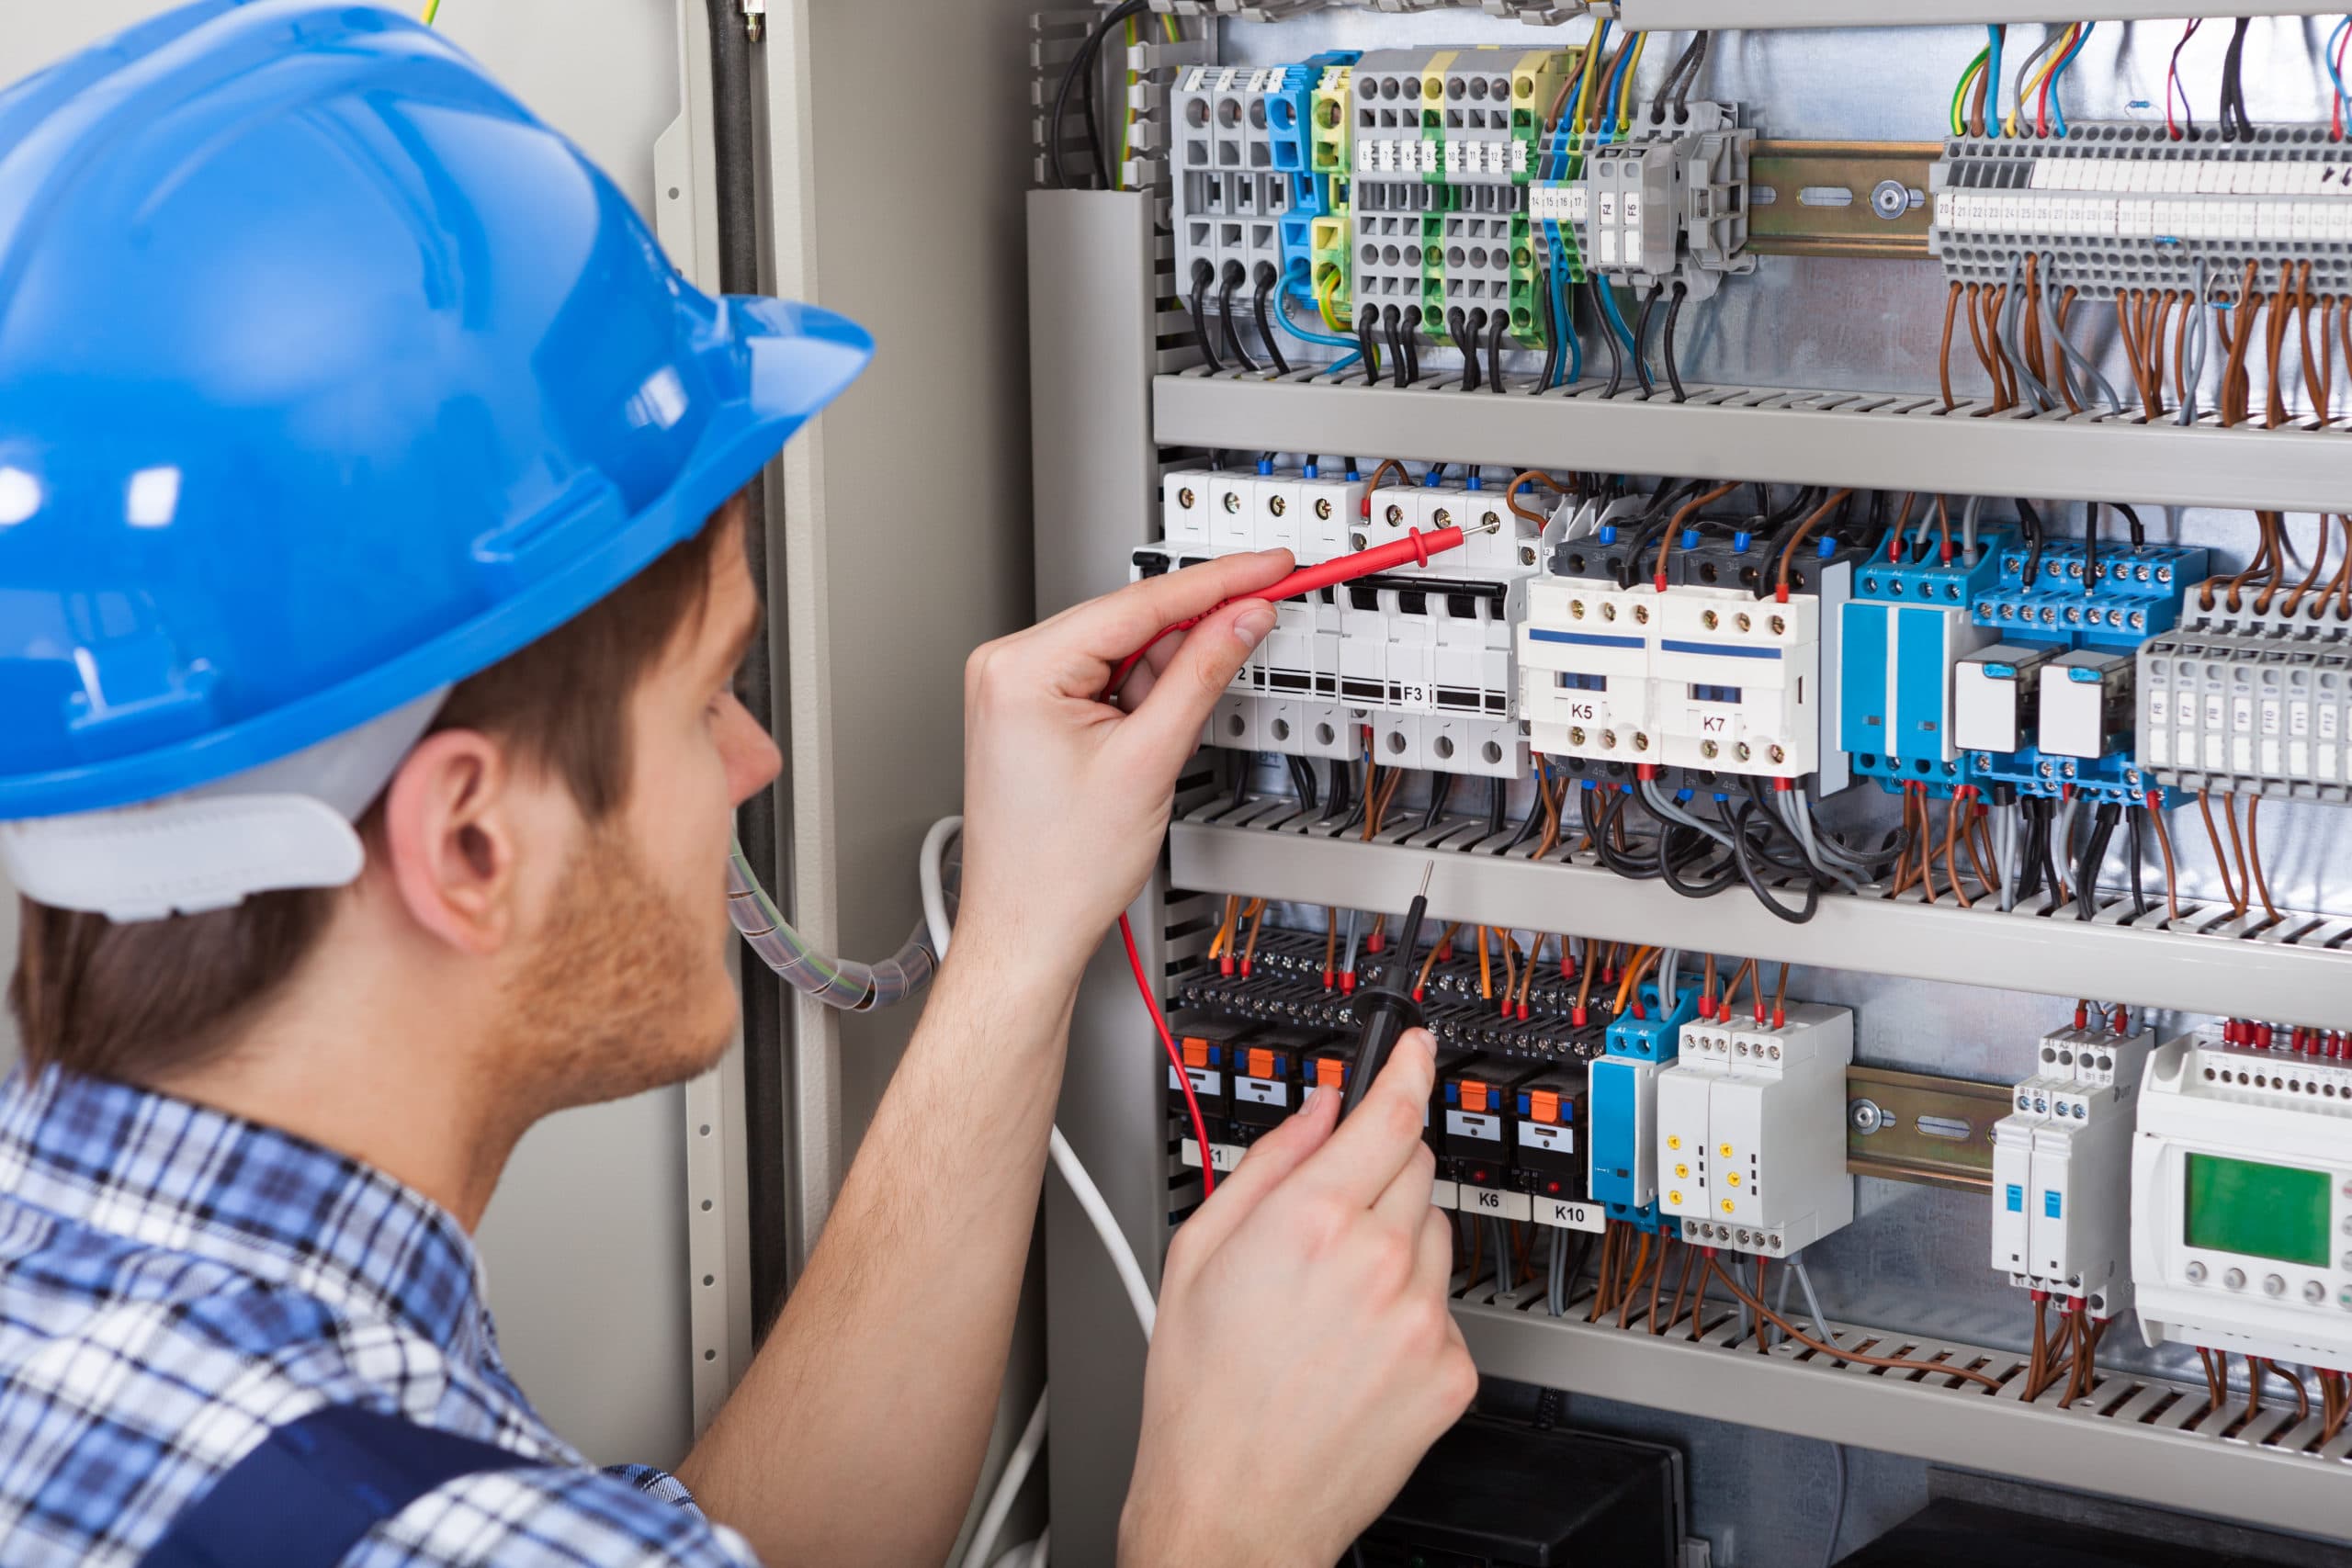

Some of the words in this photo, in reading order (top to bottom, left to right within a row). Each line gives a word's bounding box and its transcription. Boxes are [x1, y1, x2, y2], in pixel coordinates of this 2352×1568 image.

[1448, 152, 1455, 162] 10
[1469, 151, 1476, 160] 11
[1490, 152, 1498, 162] 12
[1514, 150, 1521, 160] 13
[1532, 197, 1539, 206] 14
[1546, 197, 1554, 207] 15
[1560, 197, 1567, 207] 16
[1574, 197, 1582, 207] 17
[1602, 204, 1611, 215] F4
[1939, 203, 1949, 214] 20
[1957, 206, 1966, 218] 21
[1973, 207, 1983, 218] 22
[1989, 208, 1999, 219] 23
[1403, 686, 1423, 701] F3
[1571, 703, 1593, 719] K5
[2182, 705, 2191, 717] F7
[1702, 716, 1725, 732] K7
[2265, 710, 2275, 728] F10
[1615, 1026, 1627, 1034] A1
[1637, 1028, 1649, 1037] A2
[1478, 1191, 1499, 1208] K6
[1555, 1204, 1585, 1223] K10
